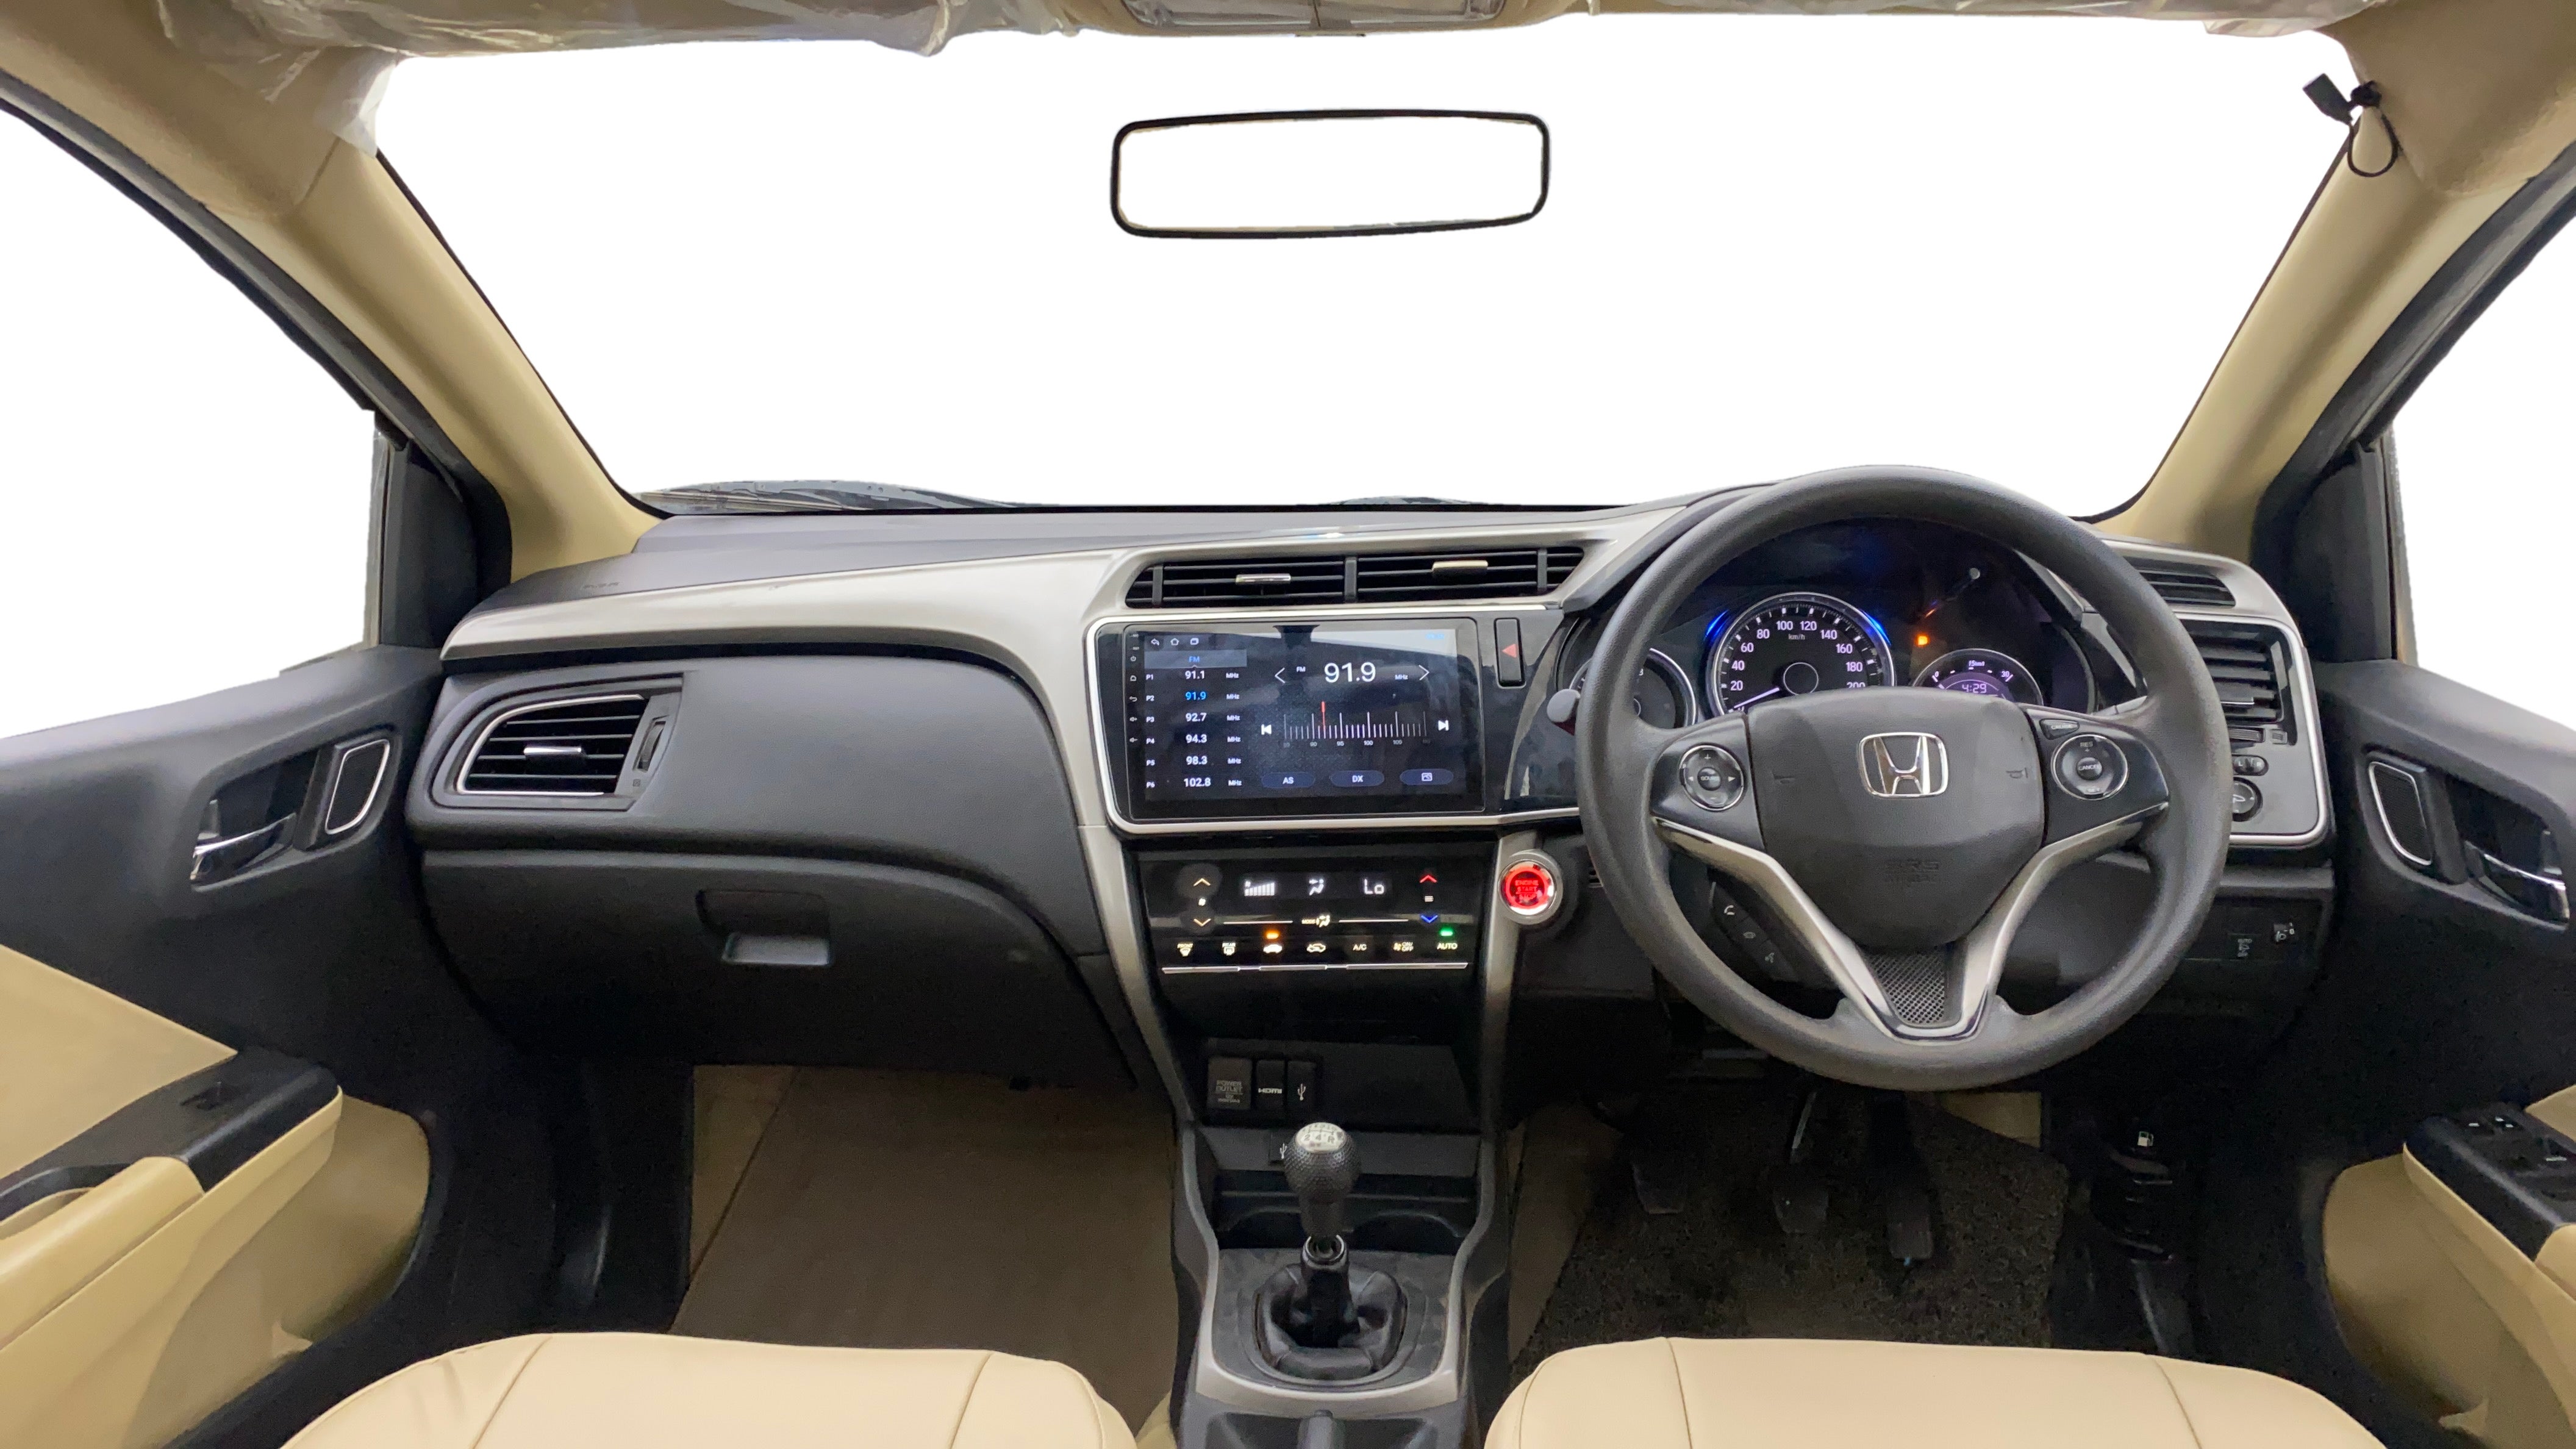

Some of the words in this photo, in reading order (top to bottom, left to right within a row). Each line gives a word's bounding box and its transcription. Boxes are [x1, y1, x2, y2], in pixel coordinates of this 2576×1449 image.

[1776, 620, 1794, 631] 100
[1800, 621, 1817, 631] 120
[1756, 629, 1770, 639] 80
[1820, 629, 1837, 640] 140
[1741, 642, 1754, 653] 60
[1836, 643, 1853, 654] 160
[1731, 660, 1745, 671] 40
[1846, 661, 1863, 672] 180
[1185, 670, 1205, 679] 91.1
[1324, 662, 1376, 683] 91.9
[1730, 680, 1744, 691] 20
[1962, 683, 1987, 693] 4:29
[1185, 691, 1207, 701] 91.9
[1185, 712, 1207, 721] 92.7
[1185, 734, 1208, 743] 94.3
[1186, 756, 1208, 765] 98.3
[1183, 777, 1211, 787] 102.8
[1282, 776, 1294, 785] AS
[1364, 878, 1384, 895] Lo
